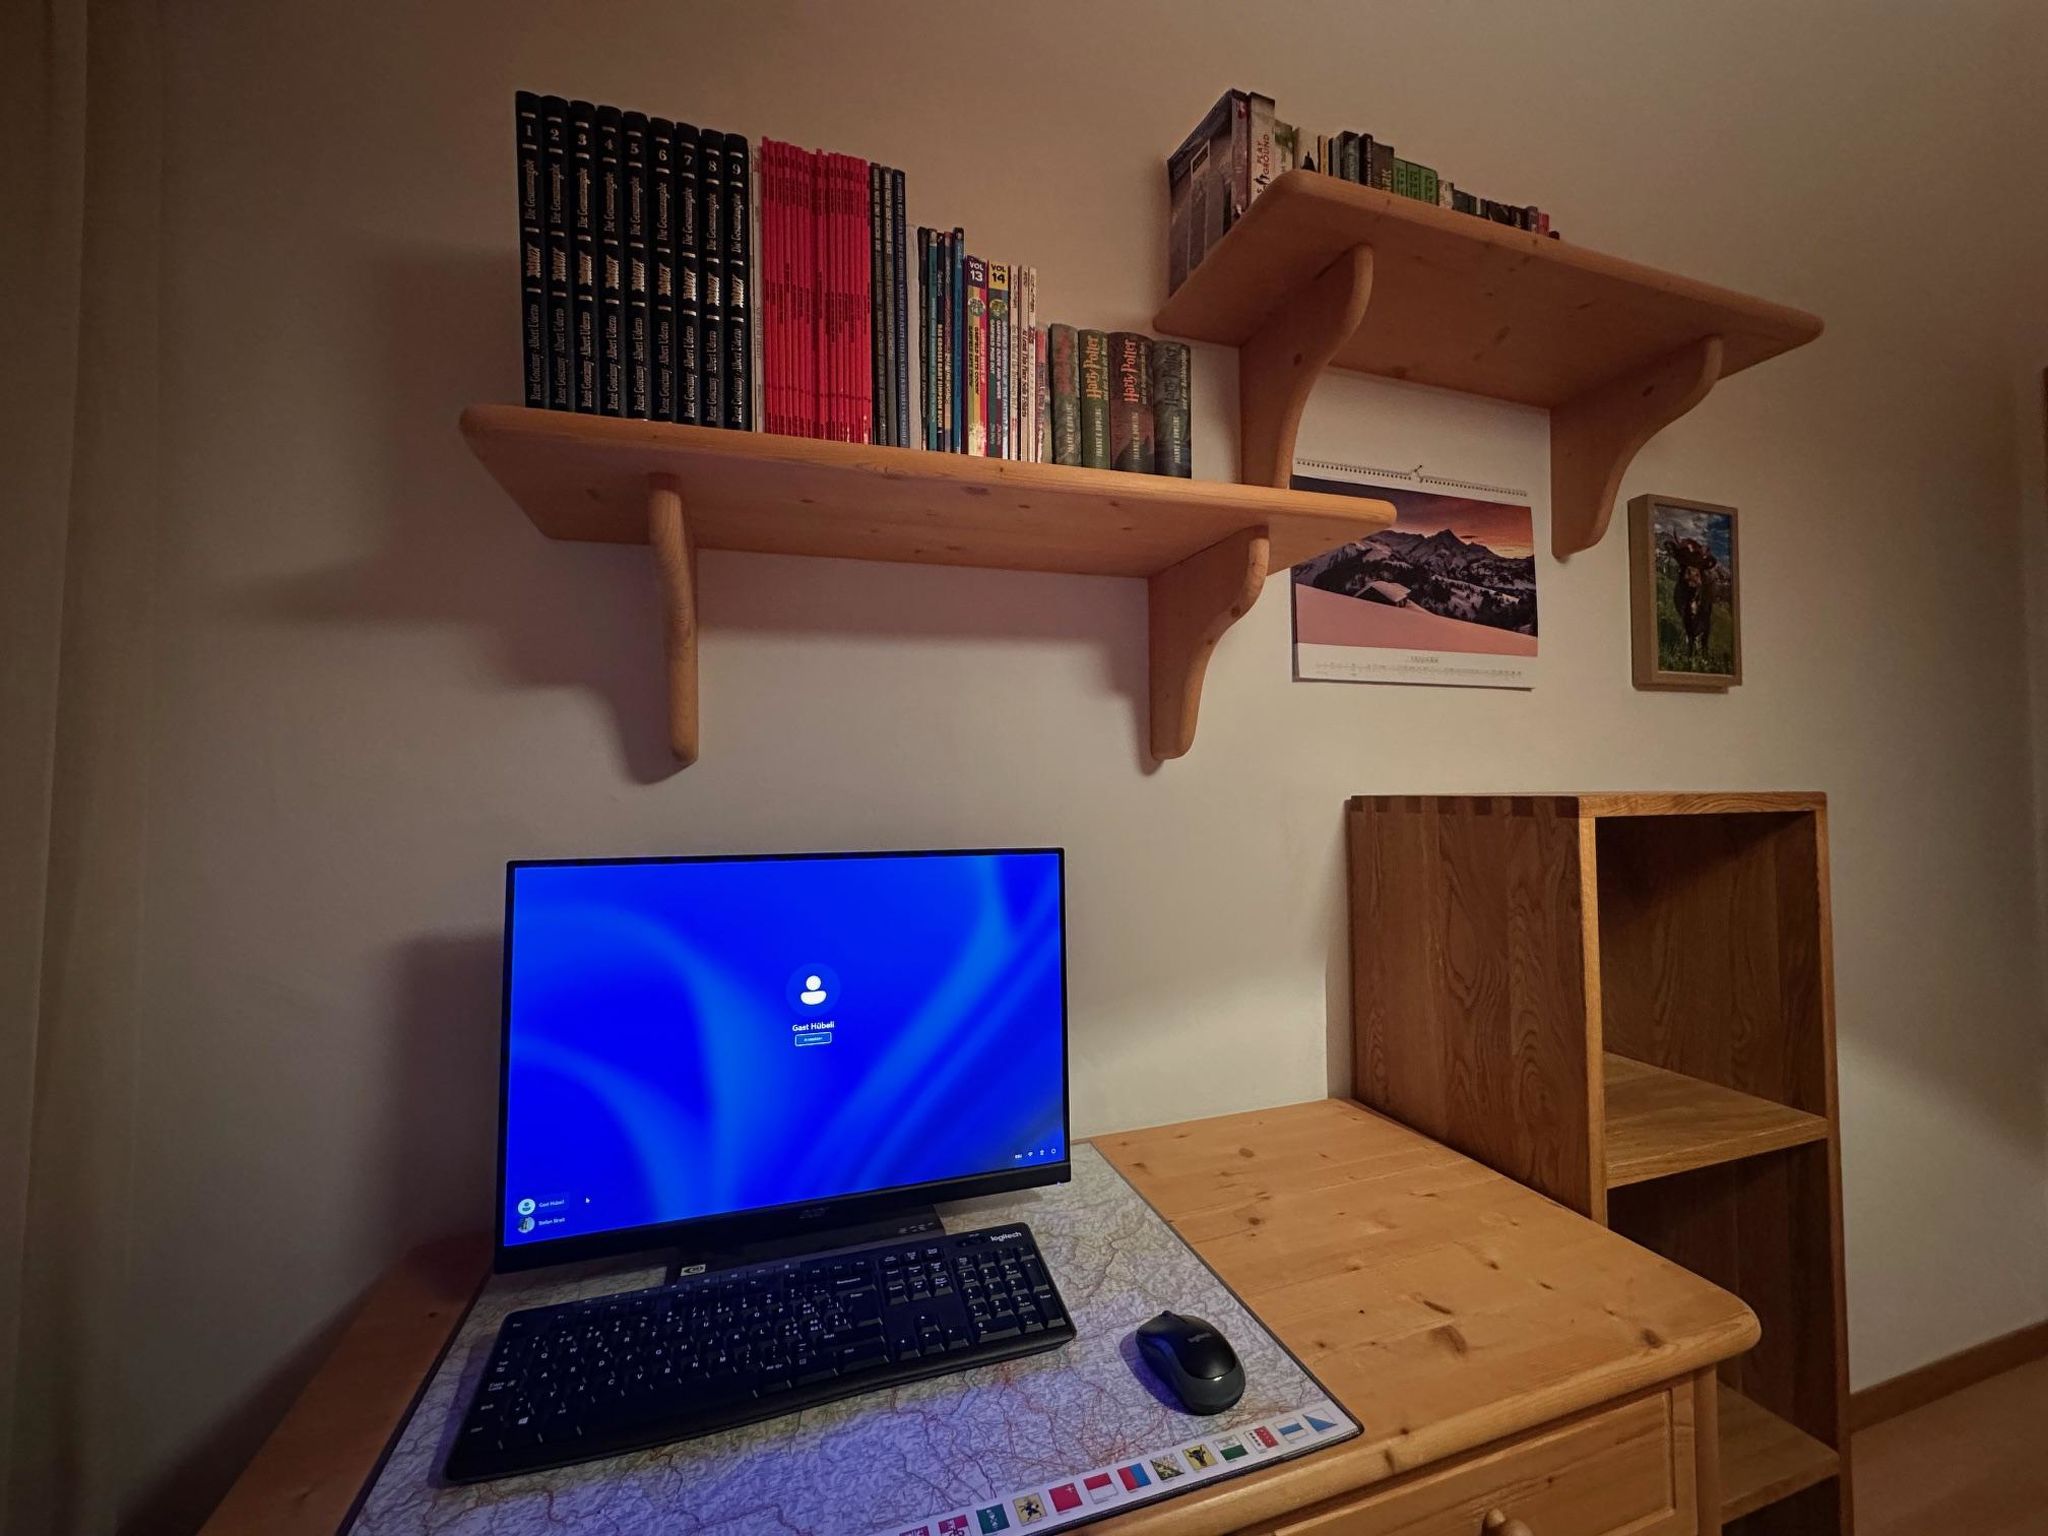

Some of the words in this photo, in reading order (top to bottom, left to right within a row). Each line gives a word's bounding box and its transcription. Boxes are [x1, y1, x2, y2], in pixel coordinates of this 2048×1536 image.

[526, 126, 532, 136] 1
[551, 129, 559, 140] 2
[578, 134, 587, 145] 3
[605, 139, 614, 150] 4
[631, 144, 639, 154] 5
[658, 149, 667, 160] 6
[684, 155, 693, 165] 7
[708, 161, 717, 171] 8
[732, 164, 741, 175] 9
[969, 261, 983, 271] VOL
[991, 264, 1006, 272] VOL
[971, 271, 983, 281] 13
[992, 273, 1005, 284] 14
[1083, 335, 1105, 369] Potter
[1120, 339, 1140, 373] Potter
[1085, 368, 1103, 399] Harry
[1123, 374, 1139, 402] Harry
[989, 1231, 1022, 1242] logitech
